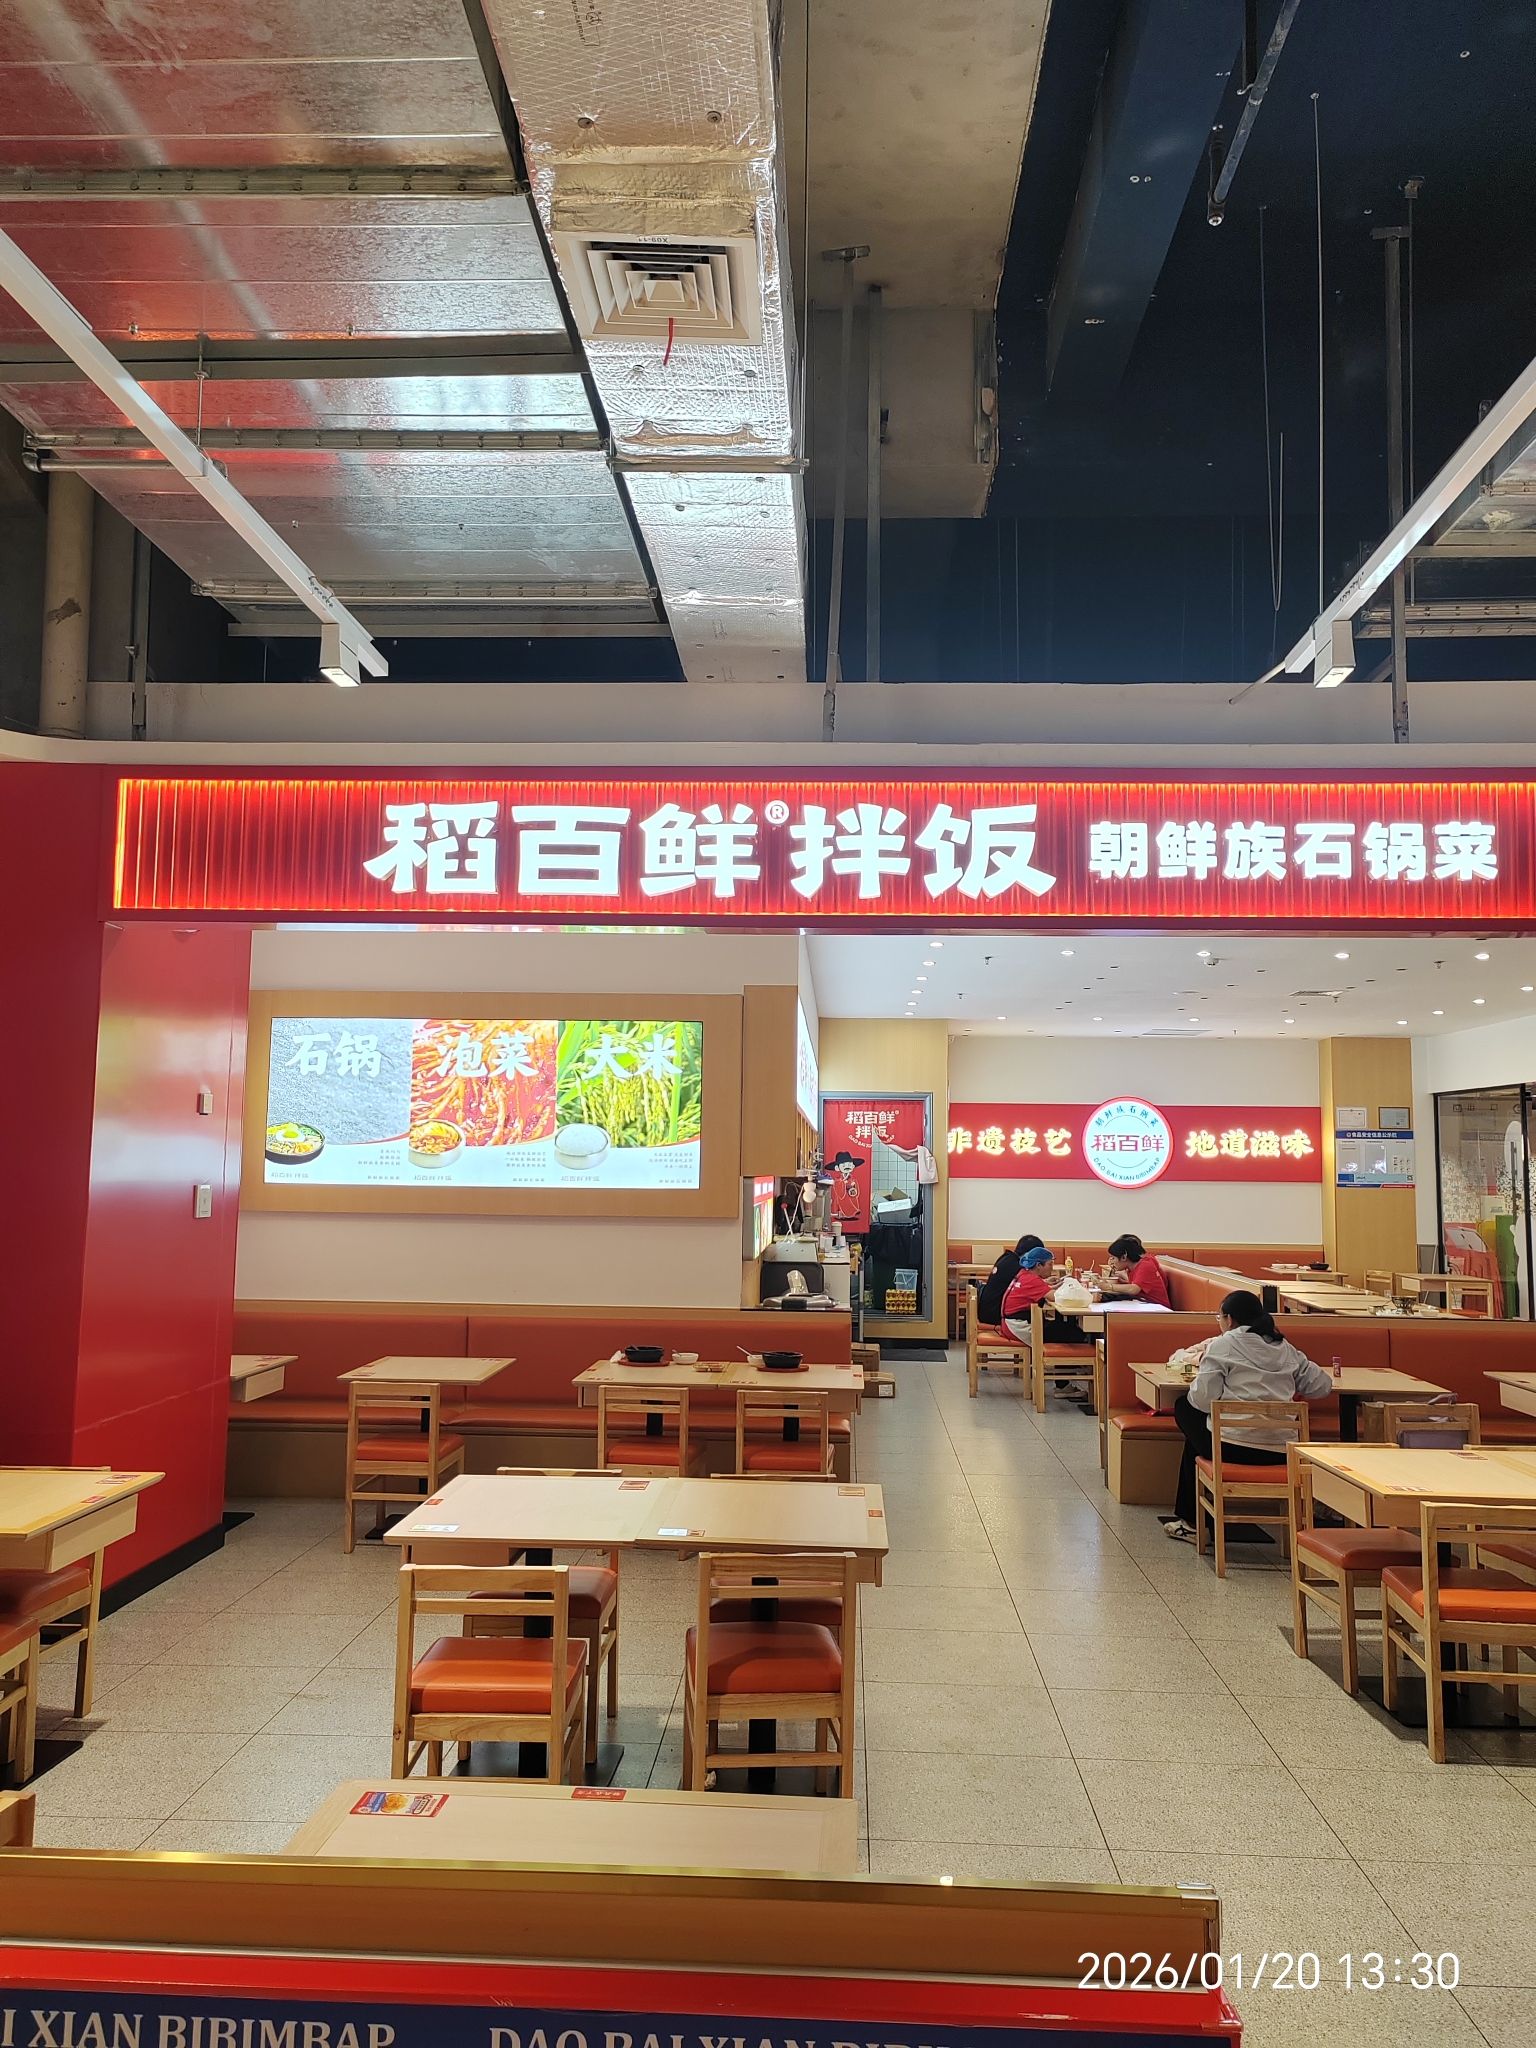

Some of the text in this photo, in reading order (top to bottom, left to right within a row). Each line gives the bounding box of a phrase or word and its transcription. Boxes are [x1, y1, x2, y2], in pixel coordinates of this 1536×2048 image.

[1088, 820, 1498, 880] 朝鲜族石锅菜
[285, 1030, 382, 1077] 石锅
[433, 1032, 539, 1080] 泡菜
[581, 1033, 683, 1080] 大米
[1090, 1134, 1165, 1152] 稻百鲜
[1185, 1129, 1315, 1158] 地道滋味
[27, 2009, 144, 2048] XIAN
